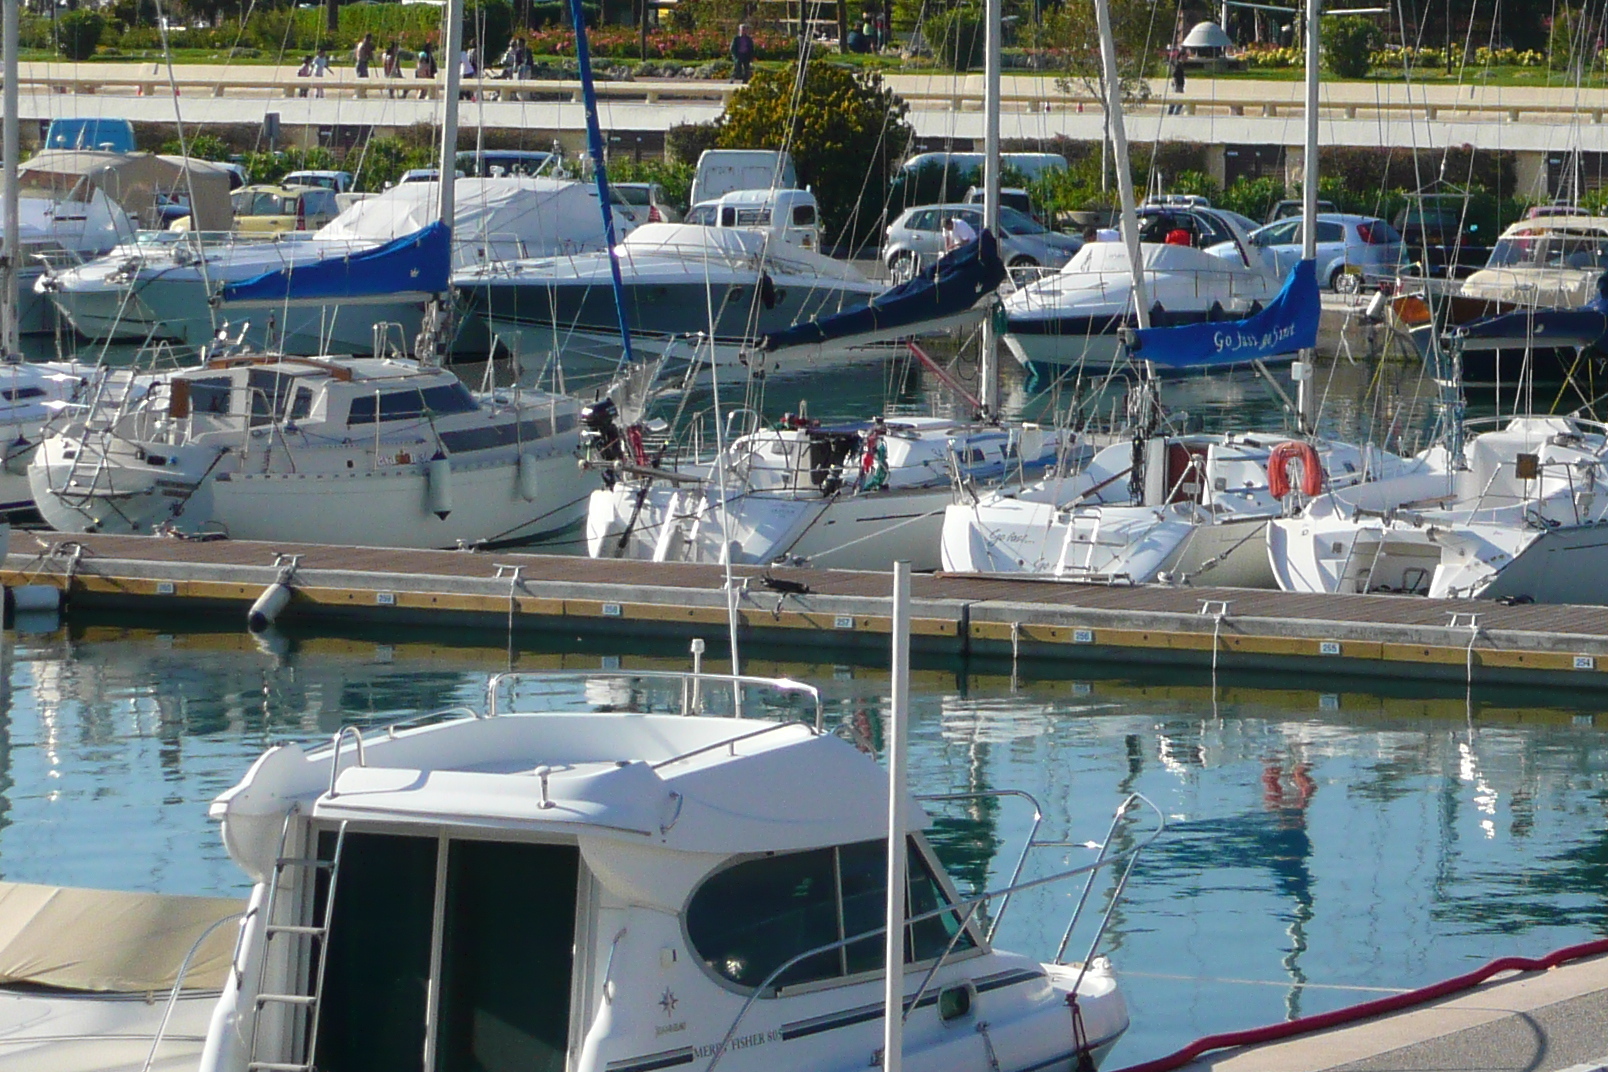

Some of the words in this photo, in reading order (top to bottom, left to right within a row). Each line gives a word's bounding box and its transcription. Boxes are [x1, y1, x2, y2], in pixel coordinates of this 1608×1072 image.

[1214, 330, 1232, 352] Go
[836, 618, 850, 626] 257
[1322, 643, 1337, 653] 255
[1575, 658, 1590, 667] 254
[731, 1031, 765, 1050] FISHER
